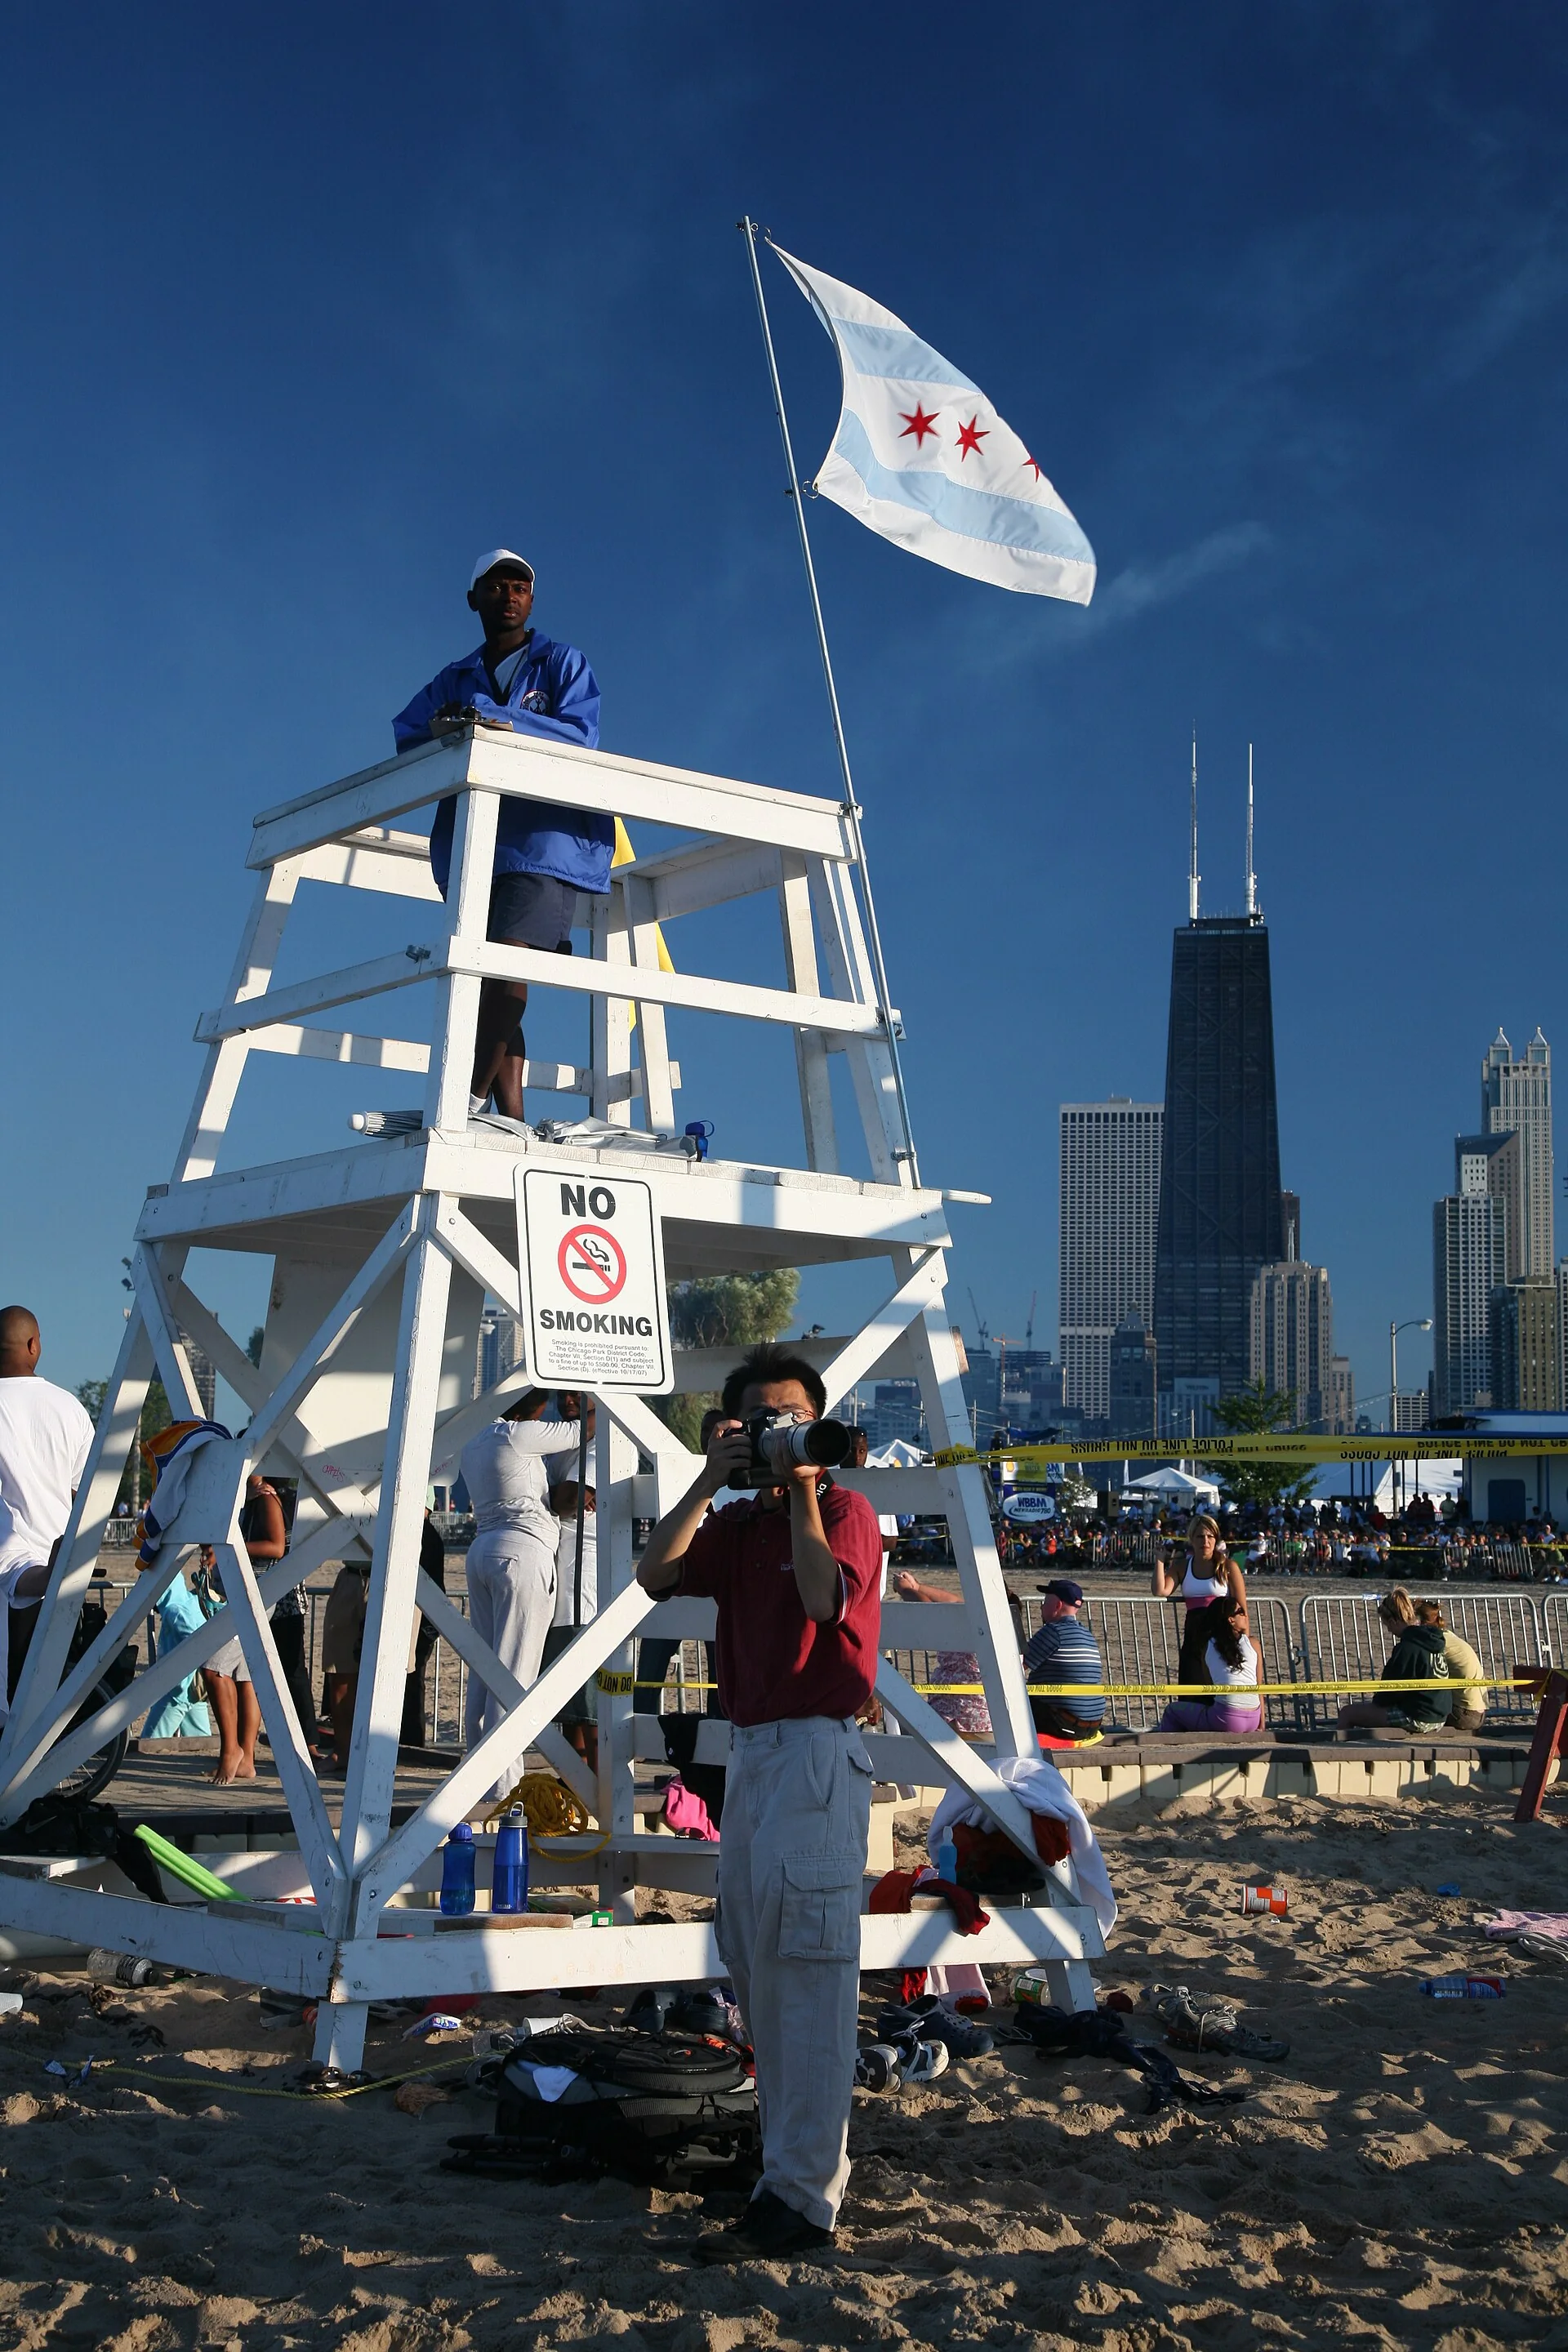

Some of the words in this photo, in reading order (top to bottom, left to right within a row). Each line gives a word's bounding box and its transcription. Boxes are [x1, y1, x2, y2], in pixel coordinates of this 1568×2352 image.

[560, 1183, 616, 1220] NO
[540, 1308, 653, 1337] SMOKING
[551, 1339, 577, 1348] Smoking
[549, 1351, 571, 1359] Chapter
[583, 1353, 605, 1361] Section
[568, 1347, 592, 1355] Chicago
[1162, 1439, 1187, 1450] LINE
[1017, 1497, 1047, 1508] WBBM
[602, 1674, 619, 1693] NOT
